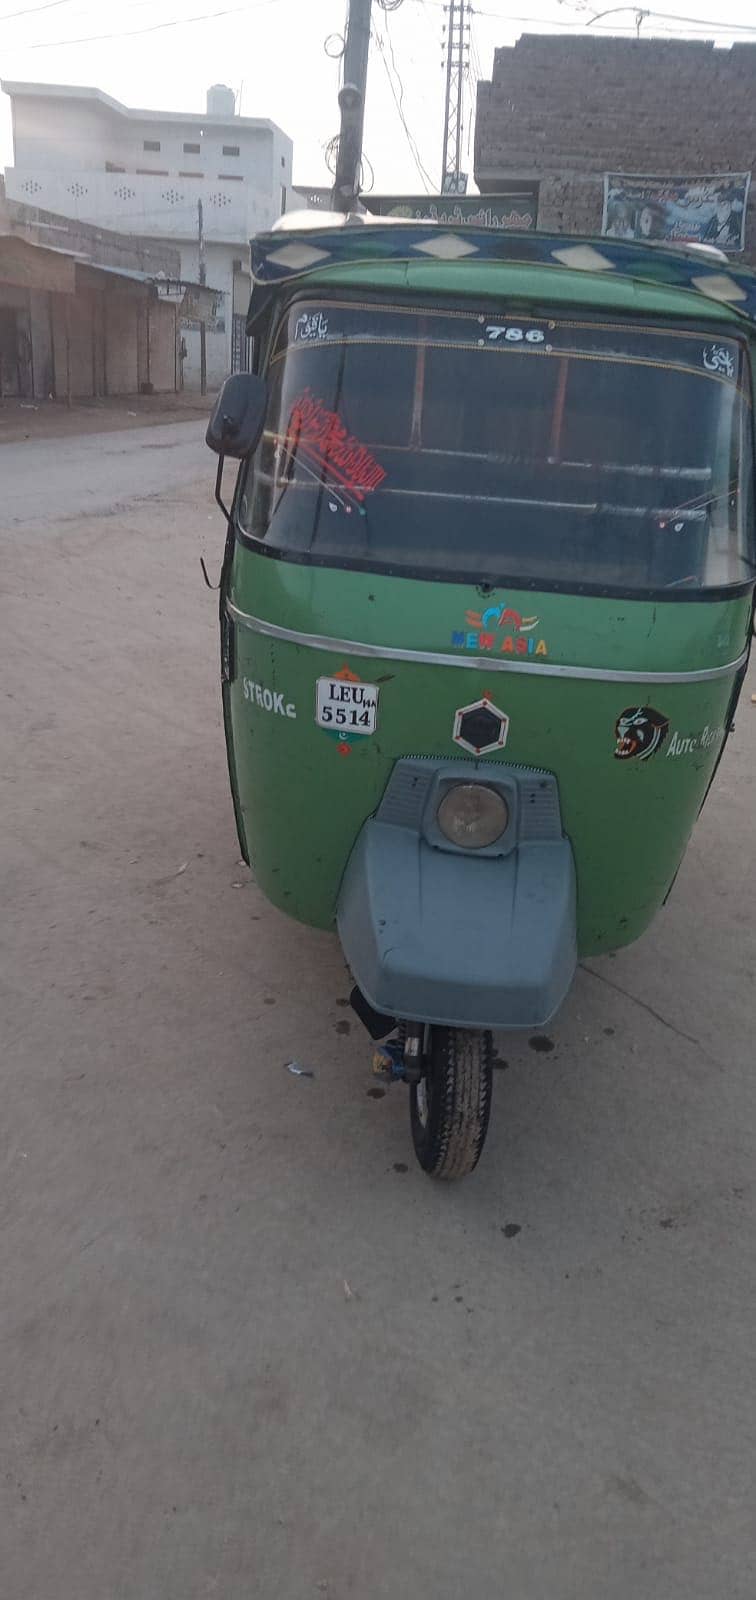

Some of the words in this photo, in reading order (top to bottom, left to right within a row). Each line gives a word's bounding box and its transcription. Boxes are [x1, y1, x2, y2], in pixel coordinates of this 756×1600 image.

[485, 326, 545, 343] 786
[452, 630, 495, 650] NEW
[501, 635, 548, 656] ASIA
[329, 683, 365, 705] LEU
[321, 706, 371, 727] 5514
